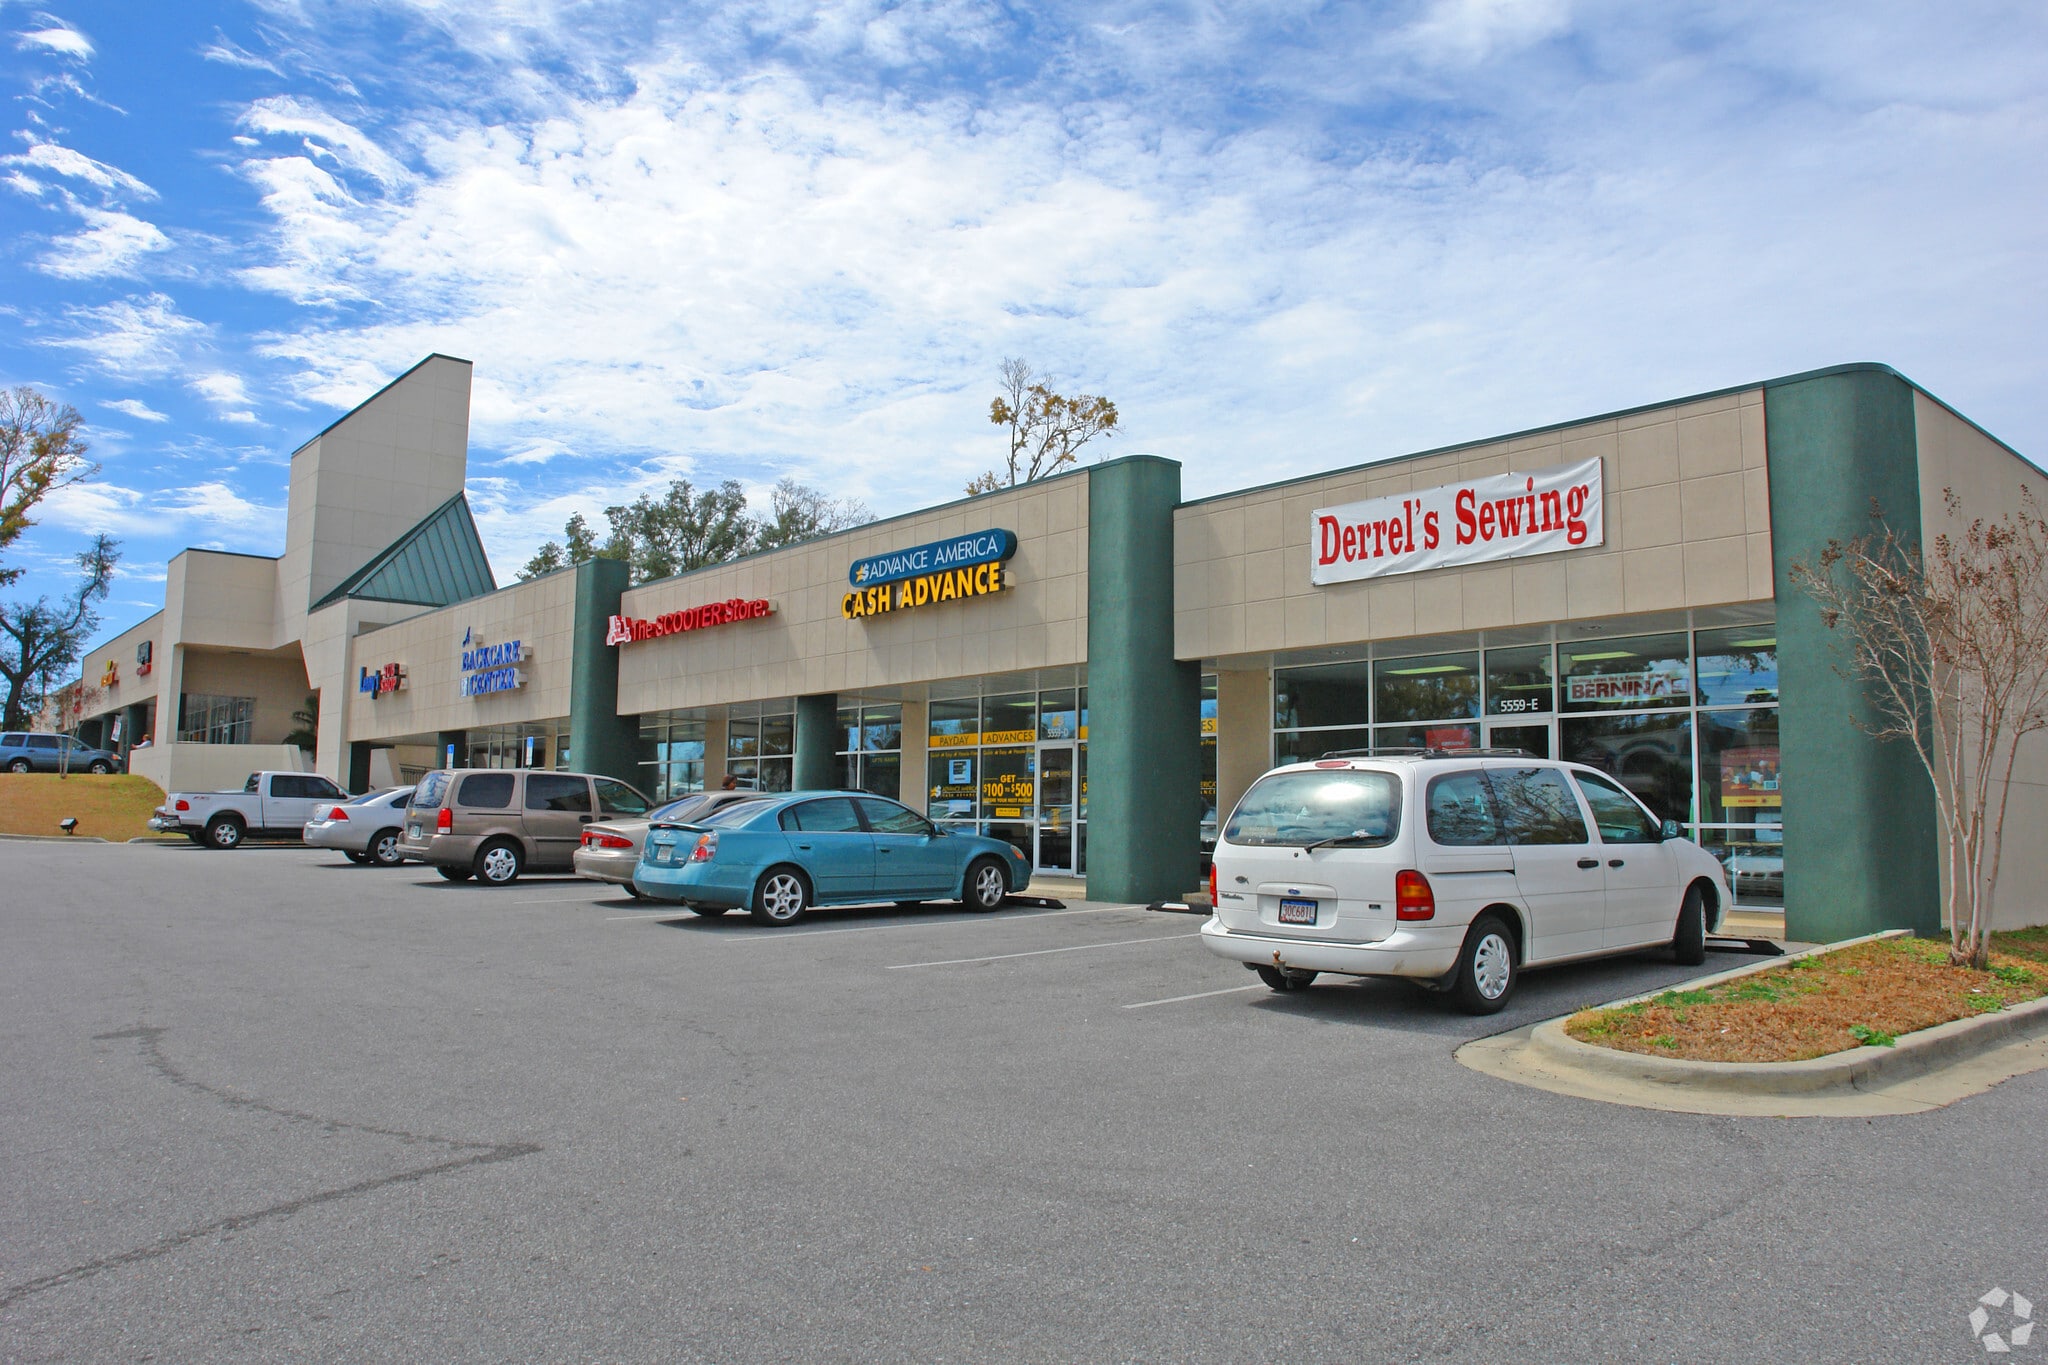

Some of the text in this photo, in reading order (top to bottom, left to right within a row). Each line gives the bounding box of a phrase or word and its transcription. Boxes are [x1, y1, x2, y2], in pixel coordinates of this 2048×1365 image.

[1319, 476, 1589, 566] Derrel's Sewing
[869, 535, 998, 580] ADVANCE AMERICA
[841, 561, 1000, 620] CASH ADVANCE
[631, 619, 652, 641] The
[656, 602, 722, 637] SCOOTER
[461, 640, 521, 672] BACKCARE
[469, 667, 516, 696] CENTER
[1572, 679, 1667, 699] BERNINA
[1500, 698, 1538, 713] 5559-E
[939, 731, 1034, 746] PAYDAY ADVANCES
[983, 783, 1004, 797] $100
[1011, 783, 1033, 797] $500
[1000, 775, 1016, 783] GET
